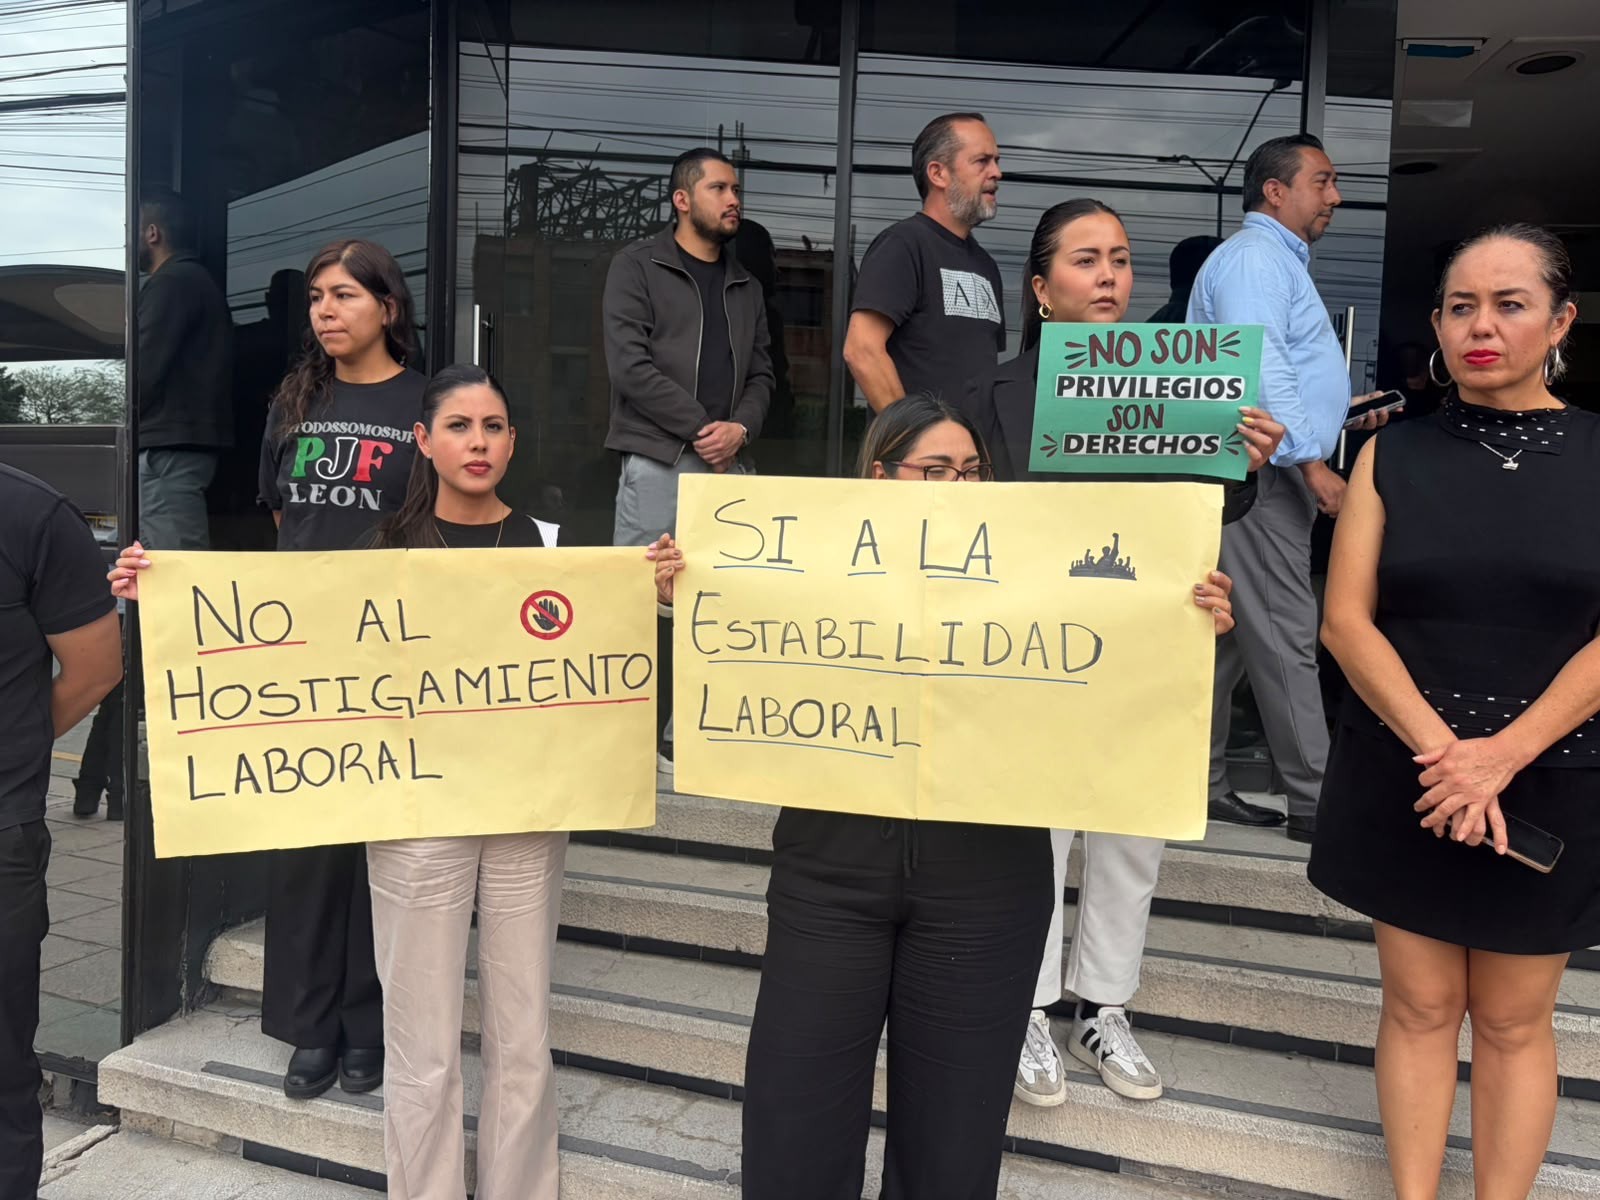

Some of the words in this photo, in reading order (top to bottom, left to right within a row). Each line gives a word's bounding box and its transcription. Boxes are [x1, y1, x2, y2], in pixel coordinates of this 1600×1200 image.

[1088, 329, 1142, 367] NO
[1151, 328, 1218, 365] SON
[1056, 375, 1243, 400] PRIVILEGIOS
[1106, 403, 1165, 432] SON
[291, 436, 393, 482] PJF
[1063, 434, 1221, 455] DERECHOS
[714, 498, 798, 565] SI
[851, 518, 881, 566] A
[919, 518, 992, 575] LA
[192, 580, 293, 646] NO
[356, 598, 432, 642] AL
[691, 590, 1104, 674] ESTABILIDAD
[166, 653, 653, 721] HOSTIGAMIENTO
[698, 683, 922, 747] LABORAL
[187, 738, 444, 801] LABORAL
